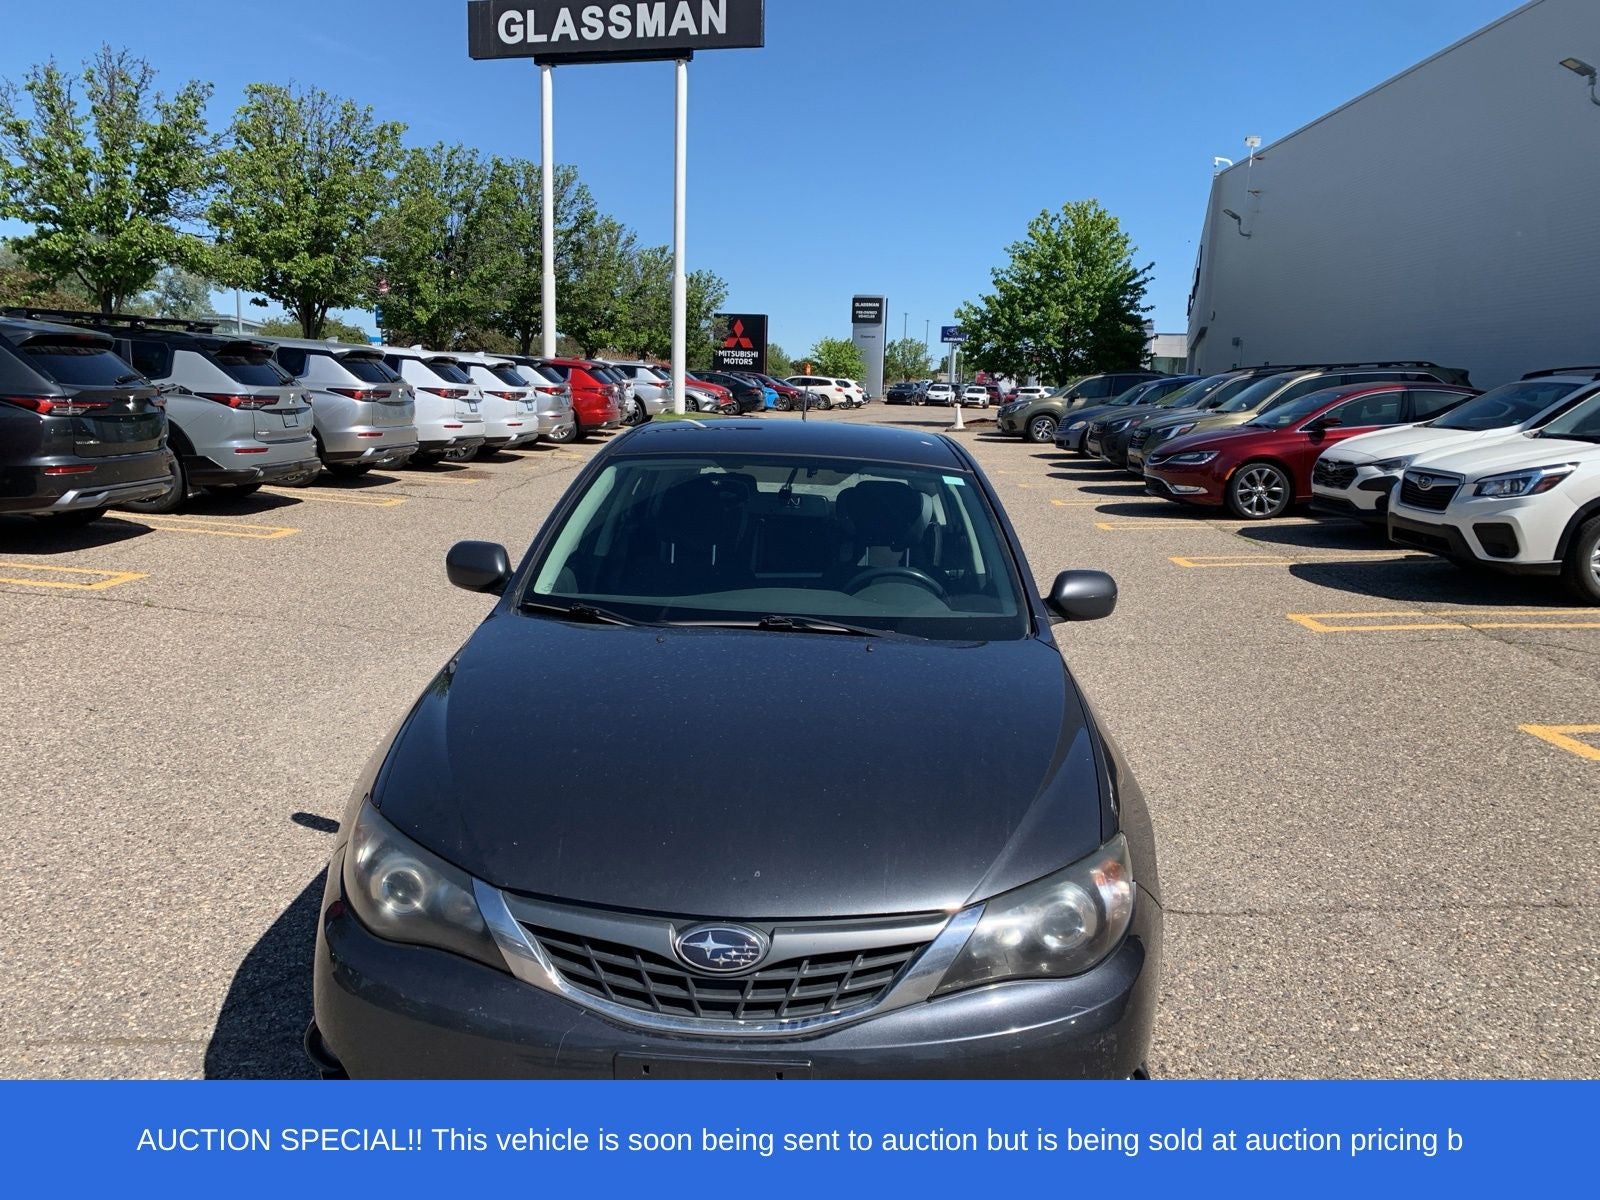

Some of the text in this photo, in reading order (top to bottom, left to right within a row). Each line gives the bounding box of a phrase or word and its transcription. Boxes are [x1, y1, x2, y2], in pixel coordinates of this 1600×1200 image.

[497, 0, 727, 44] GLASSMAN
[718, 350, 759, 358] MITSUBISHI
[723, 357, 753, 365] MOTORS
